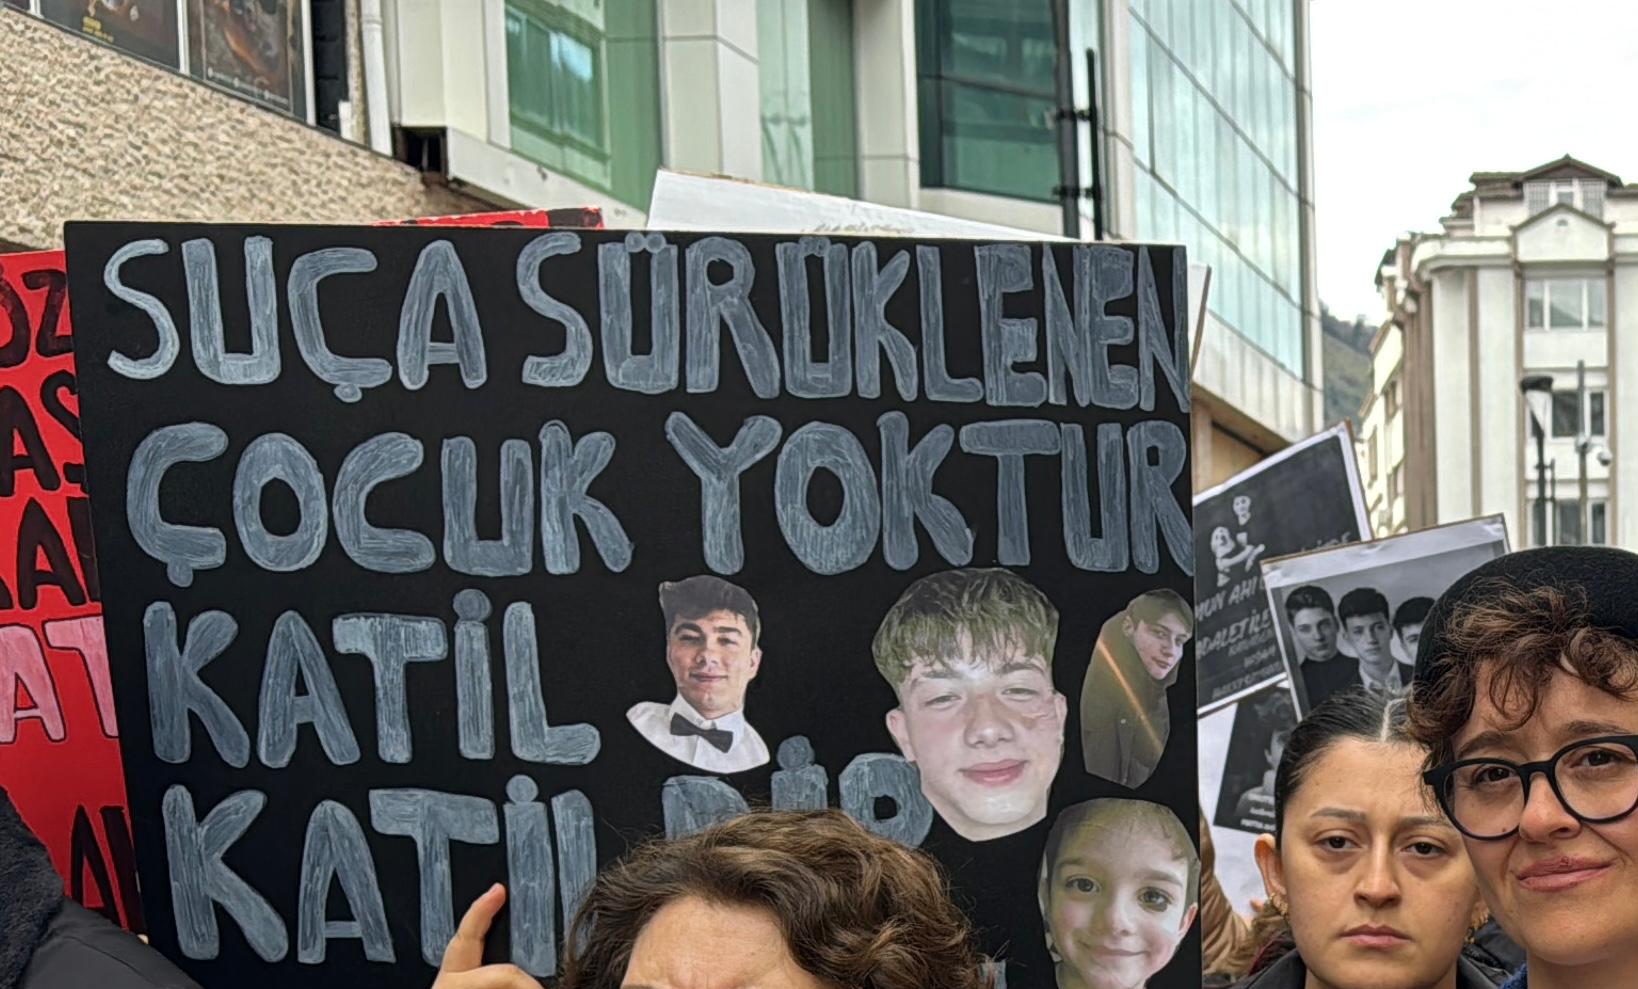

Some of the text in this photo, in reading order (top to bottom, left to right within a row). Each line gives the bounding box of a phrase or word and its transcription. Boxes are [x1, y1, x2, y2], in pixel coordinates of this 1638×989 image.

[103, 230, 1191, 413] SUÇA SÜRÜKLENEN
[126, 419, 636, 588] ÇOCUK
[664, 411, 1194, 577] YOKTUR
[142, 587, 601, 769] KATİL
